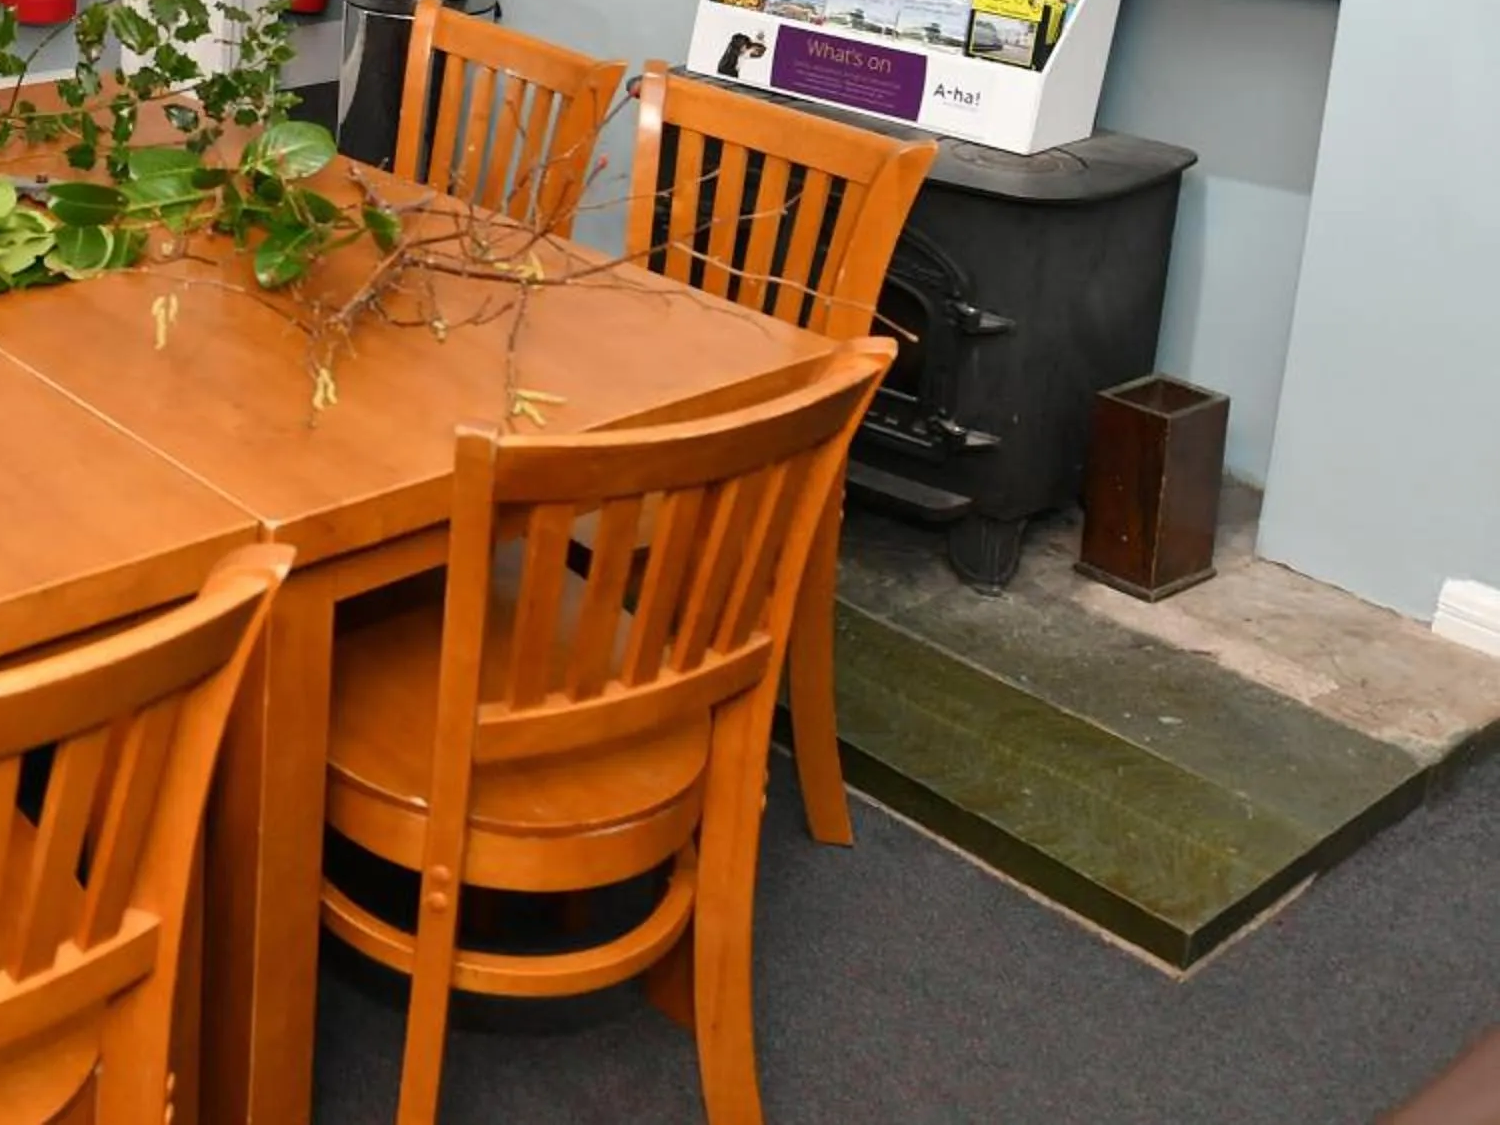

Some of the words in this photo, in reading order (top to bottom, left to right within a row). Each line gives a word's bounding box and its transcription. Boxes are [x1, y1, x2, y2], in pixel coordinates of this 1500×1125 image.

[806, 36, 864, 68] What's
[866, 55, 892, 74] on
[933, 82, 982, 107] A-ha!
